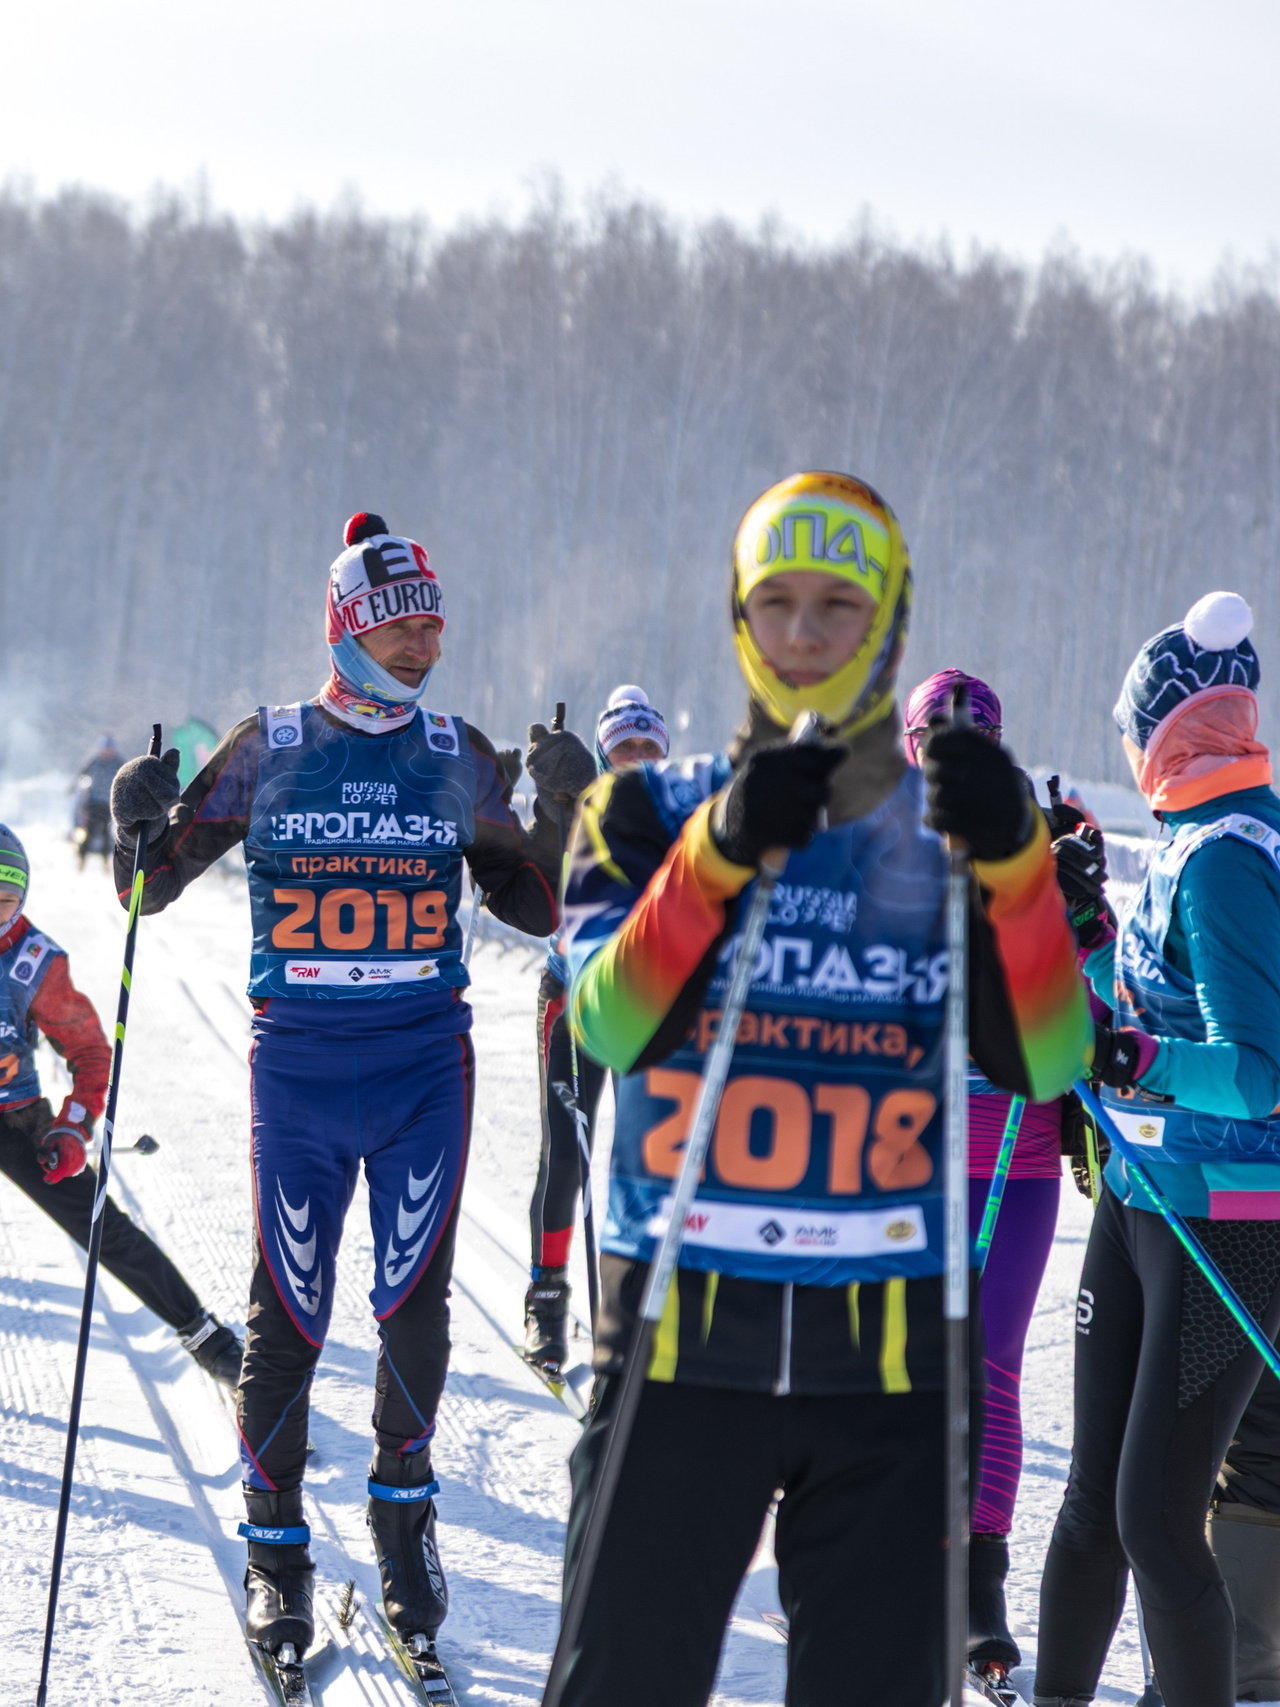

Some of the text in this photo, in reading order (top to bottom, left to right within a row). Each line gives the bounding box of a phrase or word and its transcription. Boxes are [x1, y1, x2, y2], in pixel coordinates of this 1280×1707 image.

[341, 793, 398, 806] LOPPET
[342, 781, 398, 795] RUSSIA
[291, 856, 438, 882] практика,
[271, 888, 448, 950] 2019
[290, 967, 321, 979] RAY
[687, 1006, 926, 1071] рактика,
[643, 1066, 937, 1196] 2018
